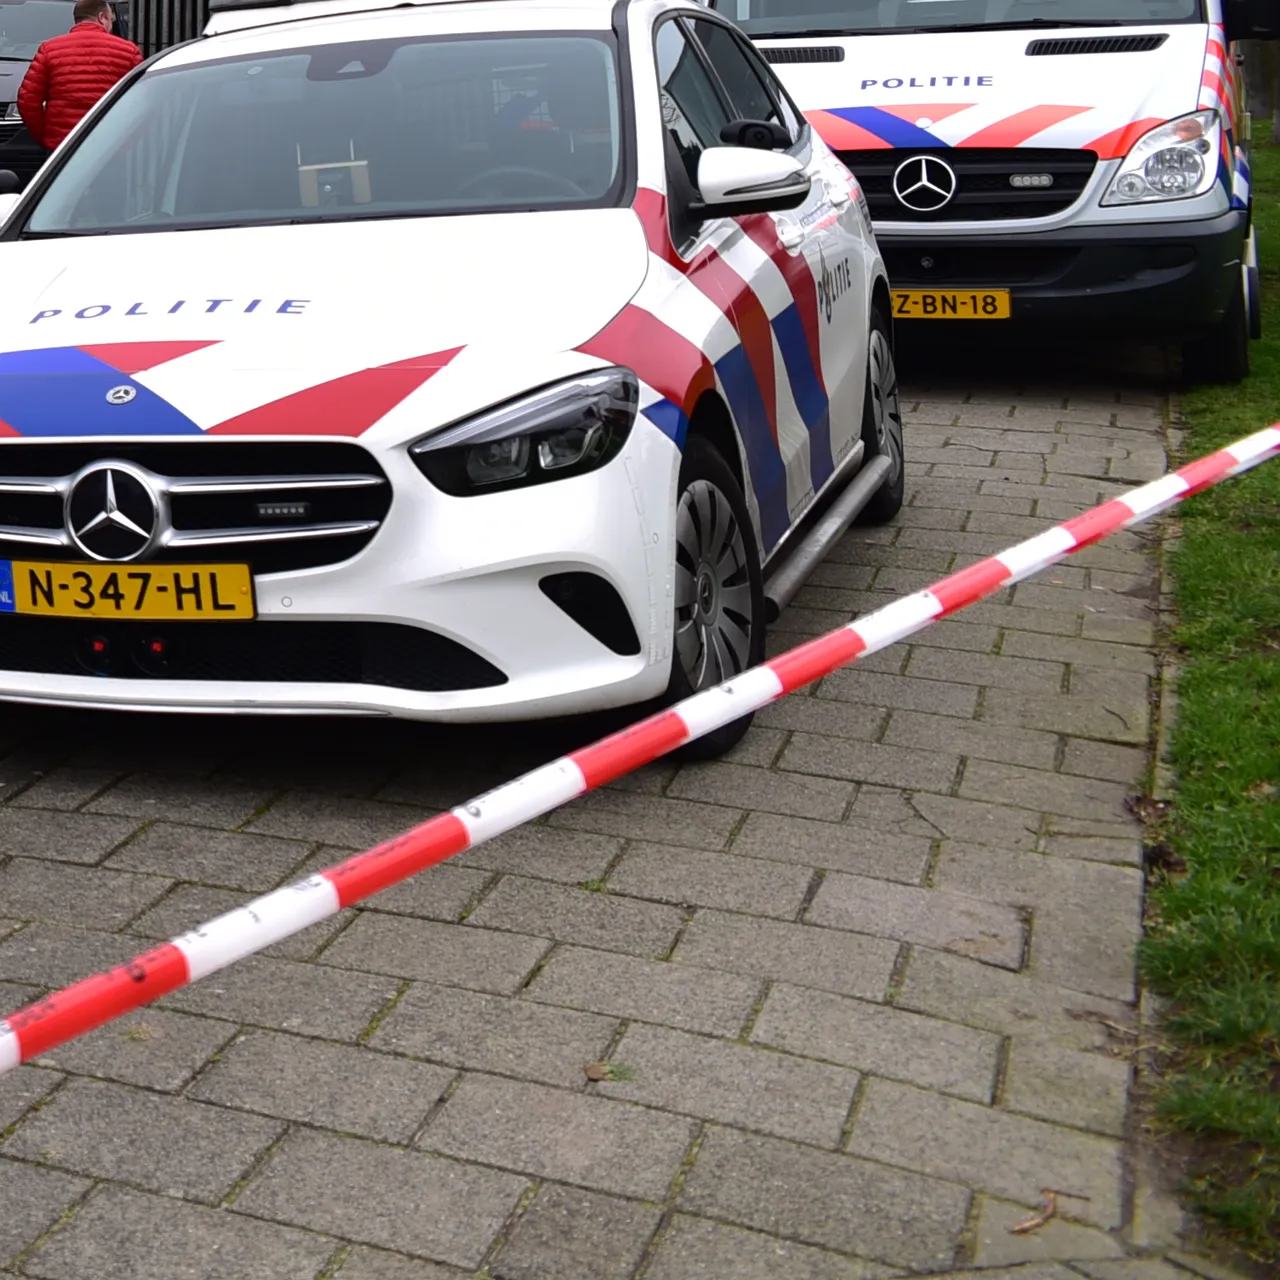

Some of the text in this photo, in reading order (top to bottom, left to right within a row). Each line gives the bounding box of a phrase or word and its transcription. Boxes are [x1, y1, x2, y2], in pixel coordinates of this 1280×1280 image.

[860, 75, 994, 90] POLITIE
[817, 257, 852, 324] POLITIE
[28, 298, 312, 325] POLITIE
[28, 569, 237, 611] N-347-HL
